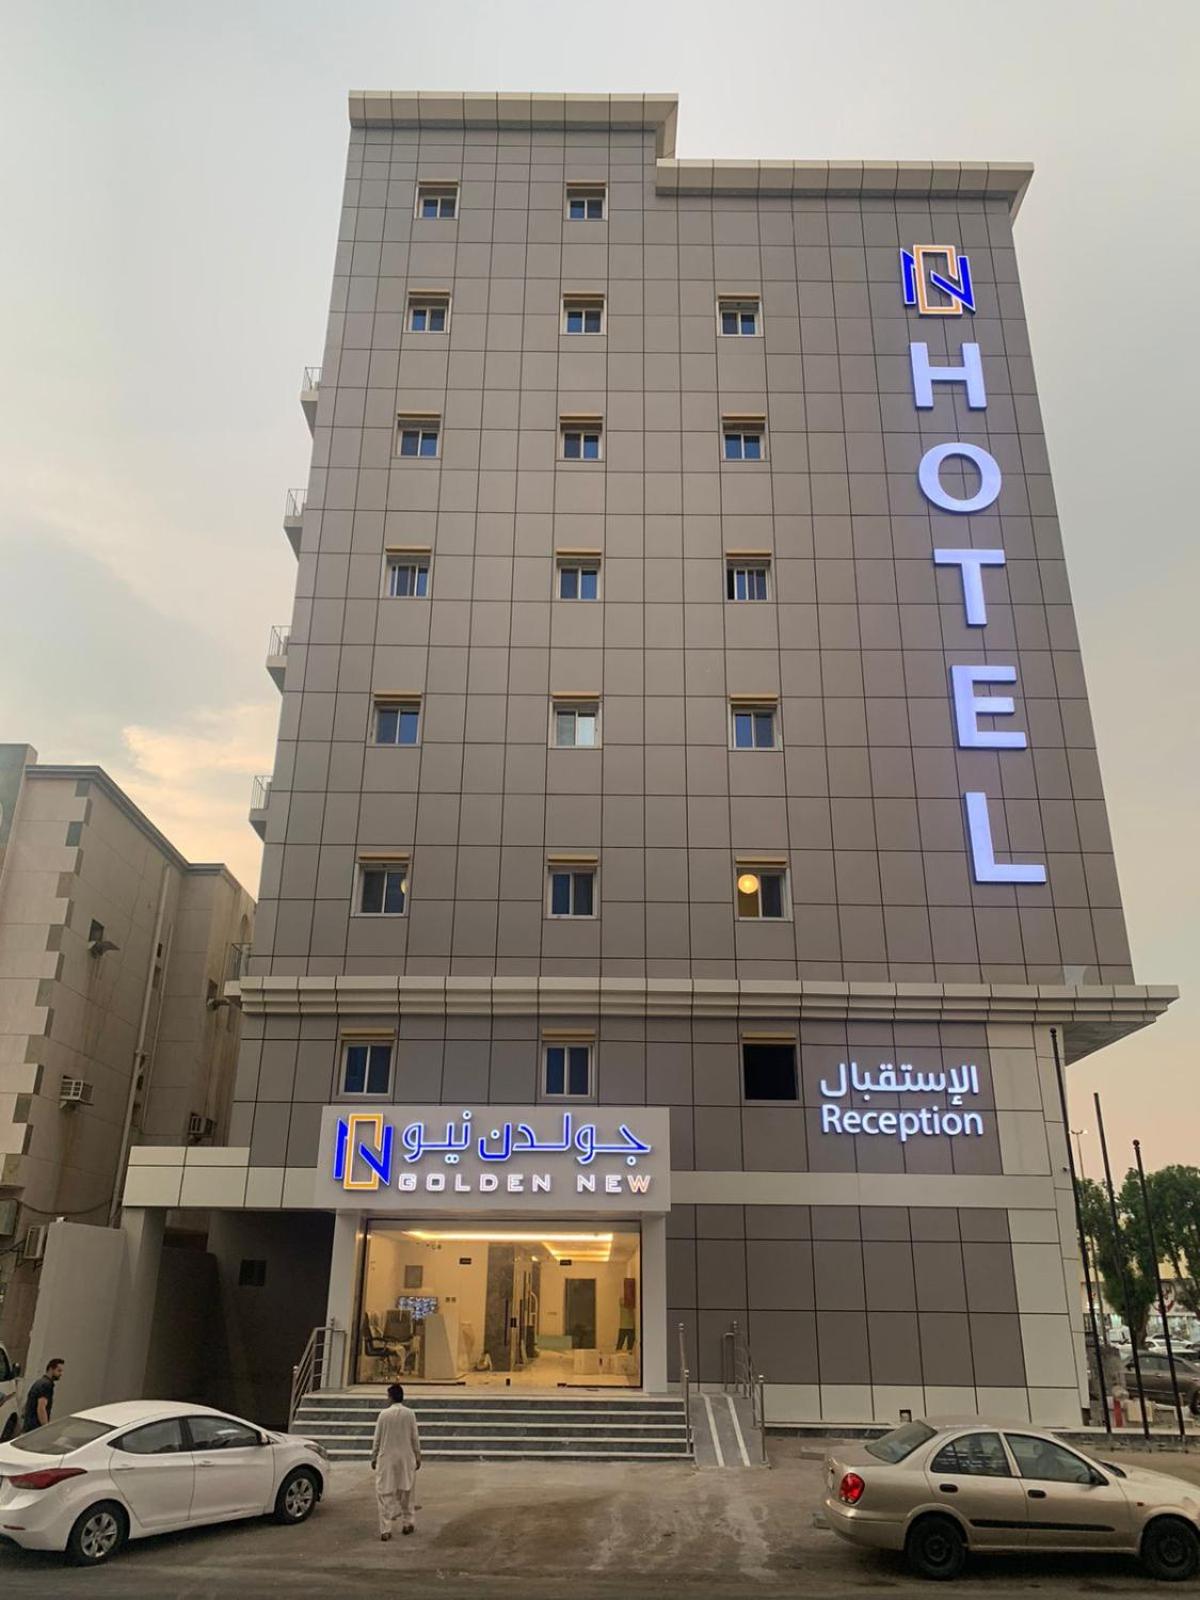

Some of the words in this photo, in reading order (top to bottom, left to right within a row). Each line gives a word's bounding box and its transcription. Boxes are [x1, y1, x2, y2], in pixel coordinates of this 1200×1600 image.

[910, 342, 1047, 883] HOTEL
[820, 1061, 979, 1105] الإستقبال
[401, 1110, 472, 1164] نيو
[477, 1111, 652, 1166] جولدن
[821, 1103, 984, 1142] Reception
[398, 1173, 551, 1192] GOLDEN
[577, 1174, 650, 1193] NEW
